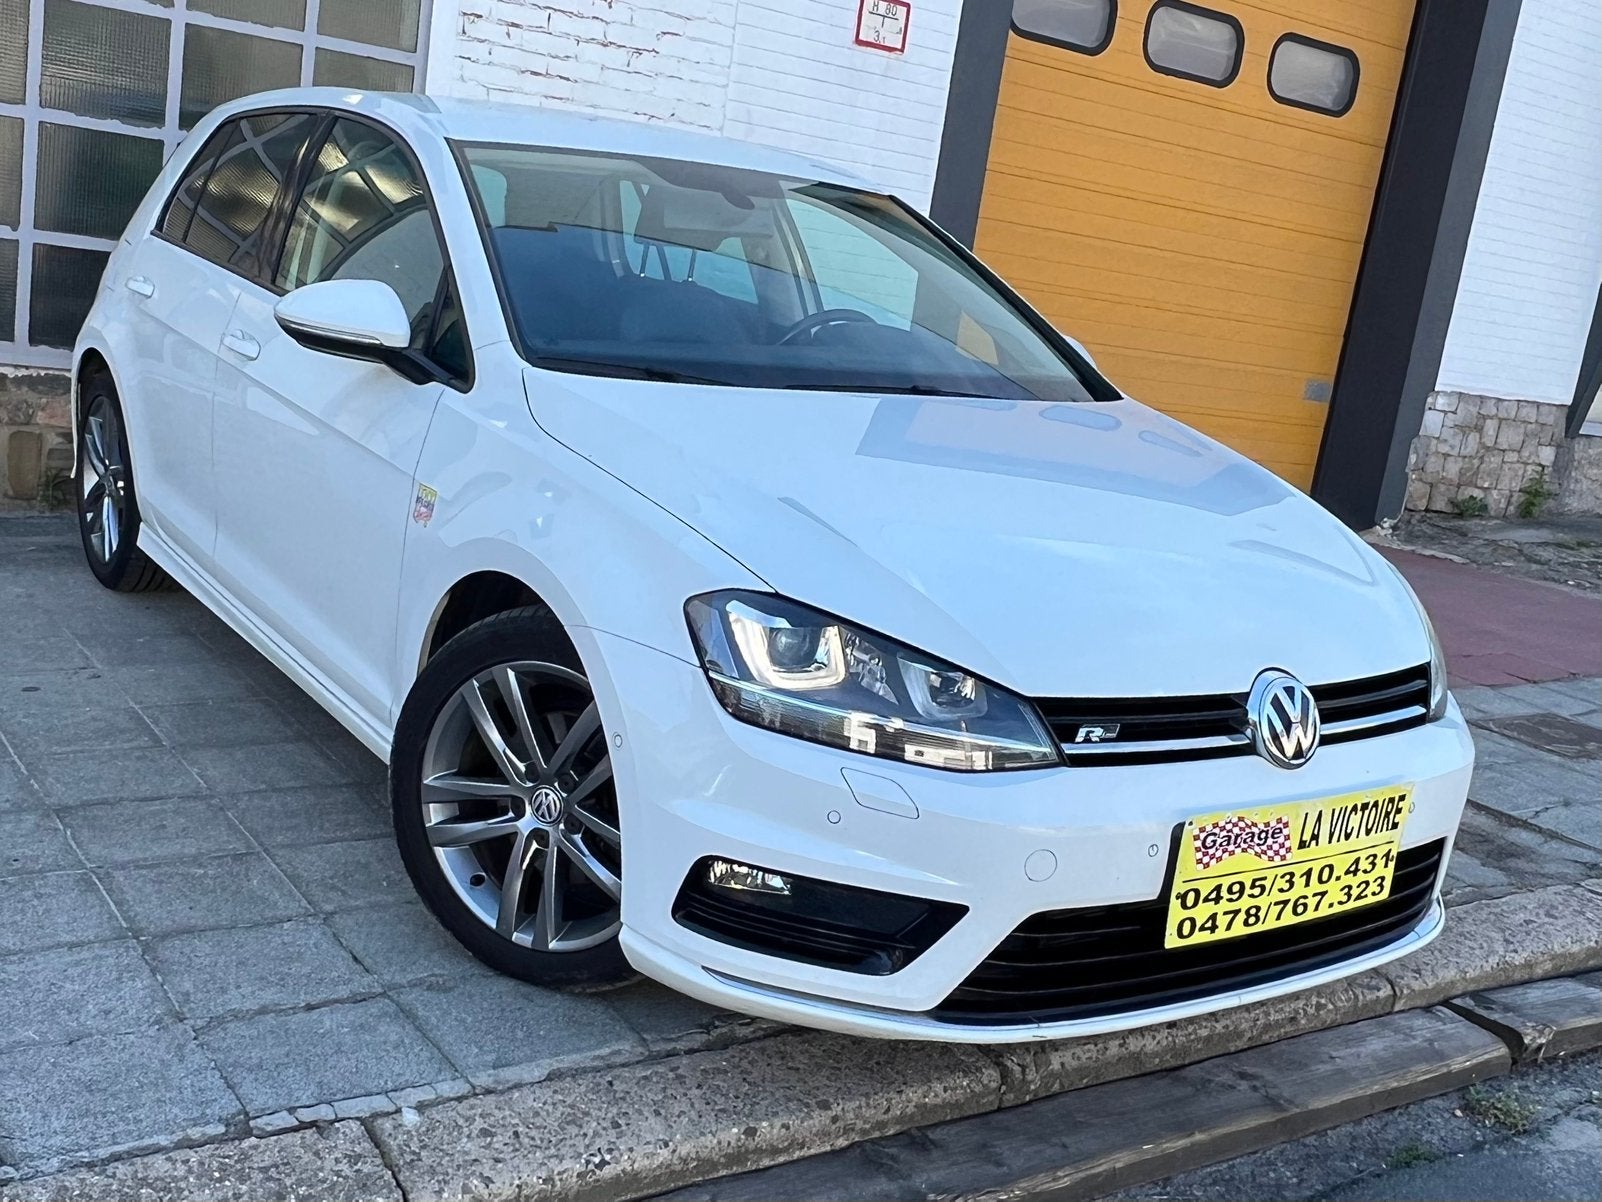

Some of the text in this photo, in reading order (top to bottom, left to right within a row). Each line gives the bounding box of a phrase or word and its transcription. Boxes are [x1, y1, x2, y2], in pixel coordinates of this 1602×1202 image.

[872, 0, 898, 16] H 80
[1201, 794, 1407, 852] Garage LA VICTOIRE
[1176, 875, 1386, 940] 0478/767.323
[1179, 848, 1392, 911] 0495/310.431
